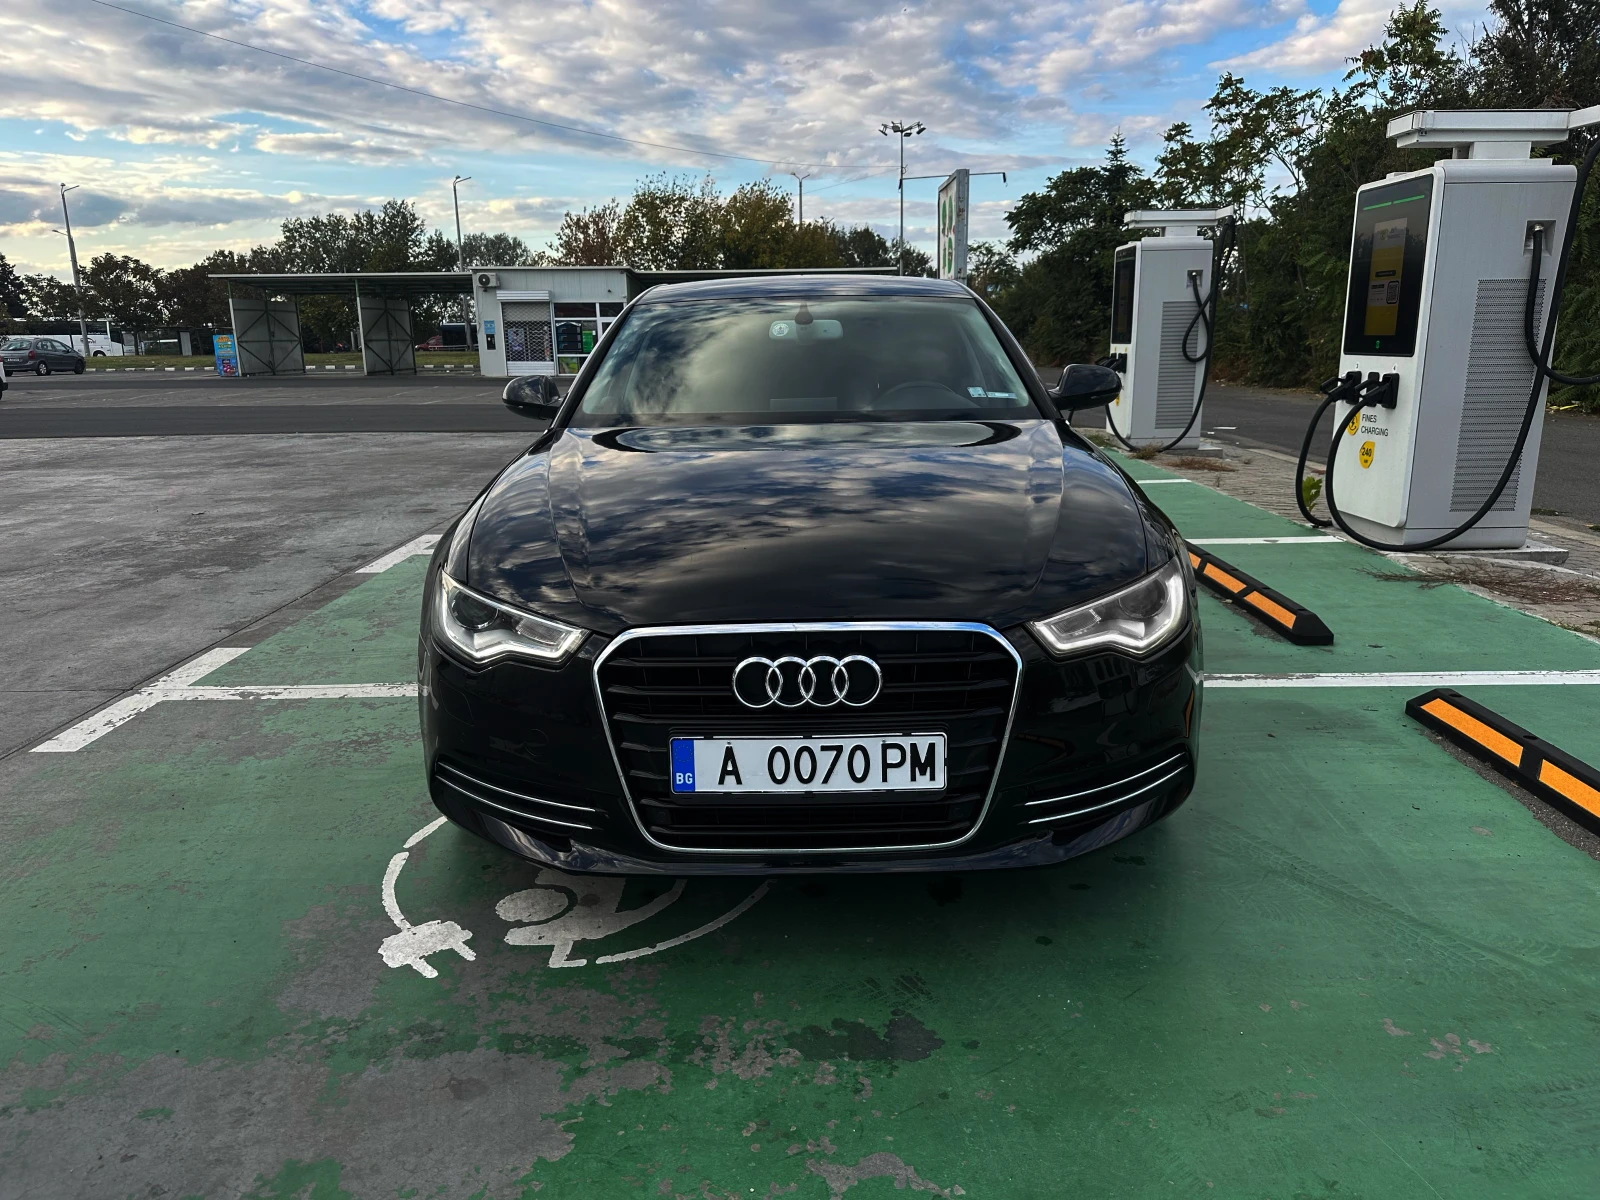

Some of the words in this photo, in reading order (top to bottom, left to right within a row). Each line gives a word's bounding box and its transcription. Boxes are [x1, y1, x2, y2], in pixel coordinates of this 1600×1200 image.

[1361, 414, 1377, 423] FINES
[1361, 426, 1389, 437] CHARGING
[1361, 447, 1372, 457] 240
[717, 745, 743, 785] A
[675, 772, 693, 785] BG
